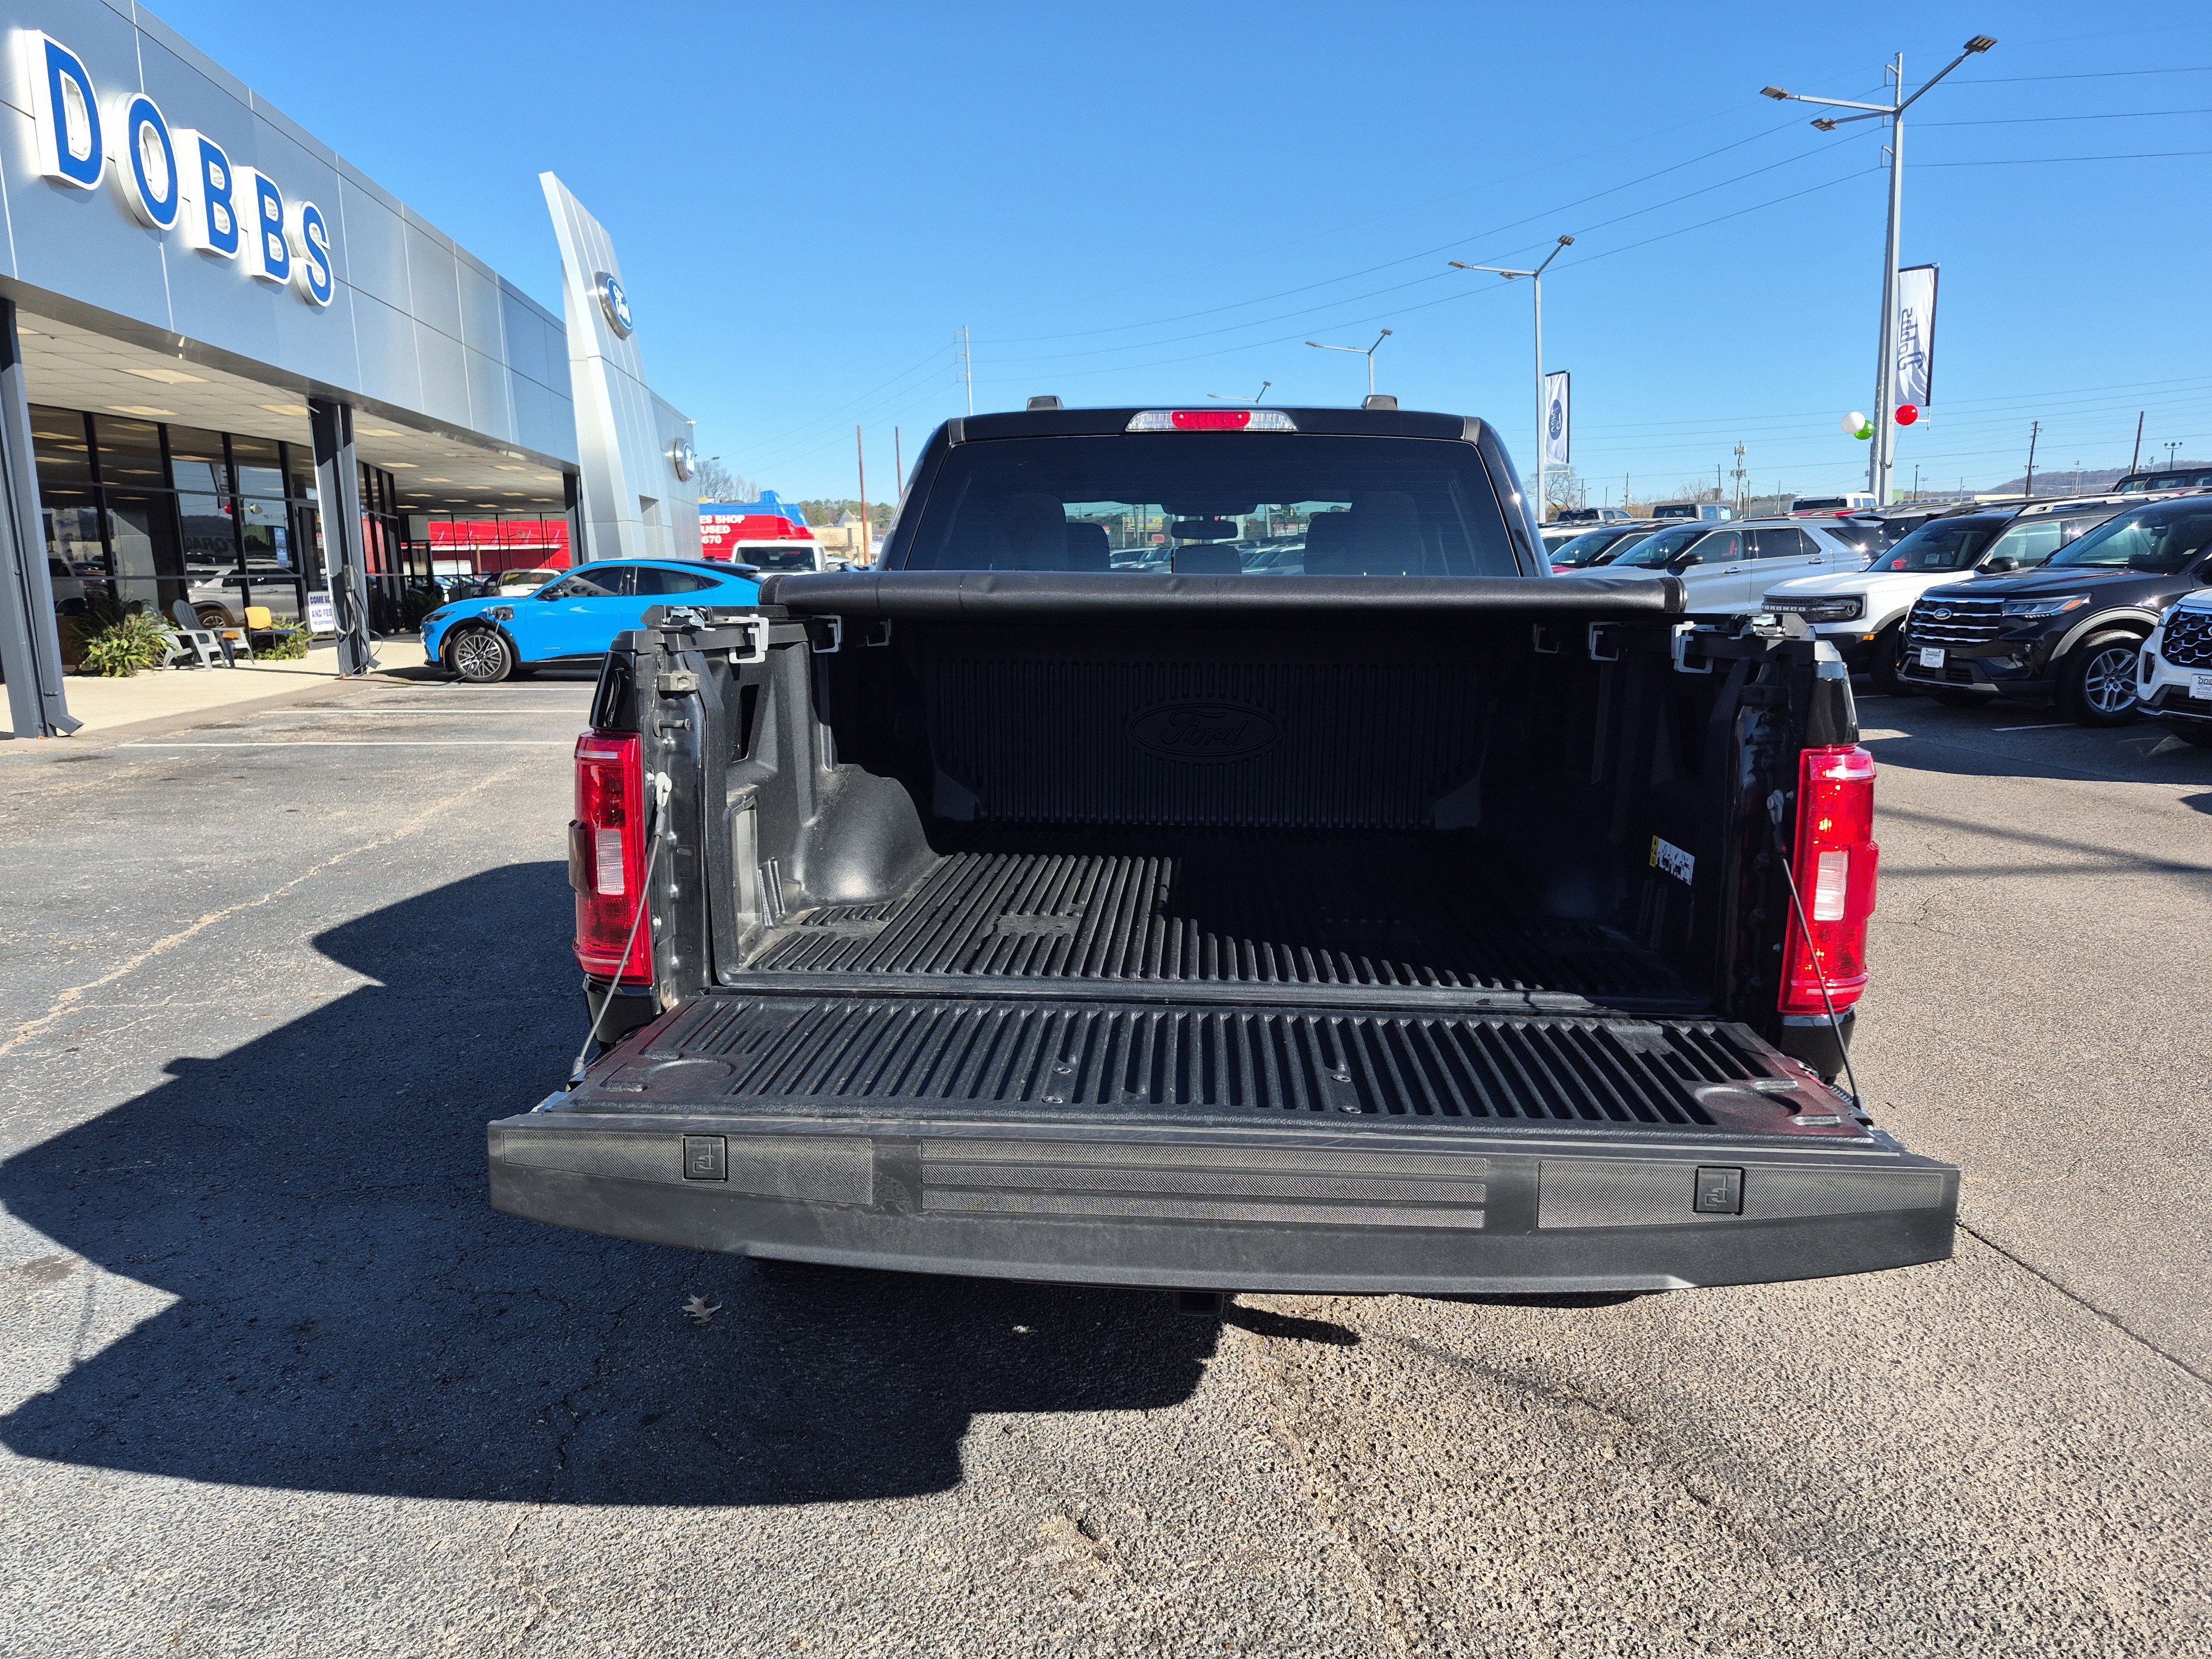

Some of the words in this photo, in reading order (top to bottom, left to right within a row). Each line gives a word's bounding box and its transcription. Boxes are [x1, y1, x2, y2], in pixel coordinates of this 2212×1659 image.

[26, 30, 335, 307] DOBBS
[715, 515, 745, 524] SHOP
[700, 525, 731, 535] USED
[310, 595, 324, 605] COME
[312, 609, 322, 618] AND
[1160, 709, 1248, 747] Ford
